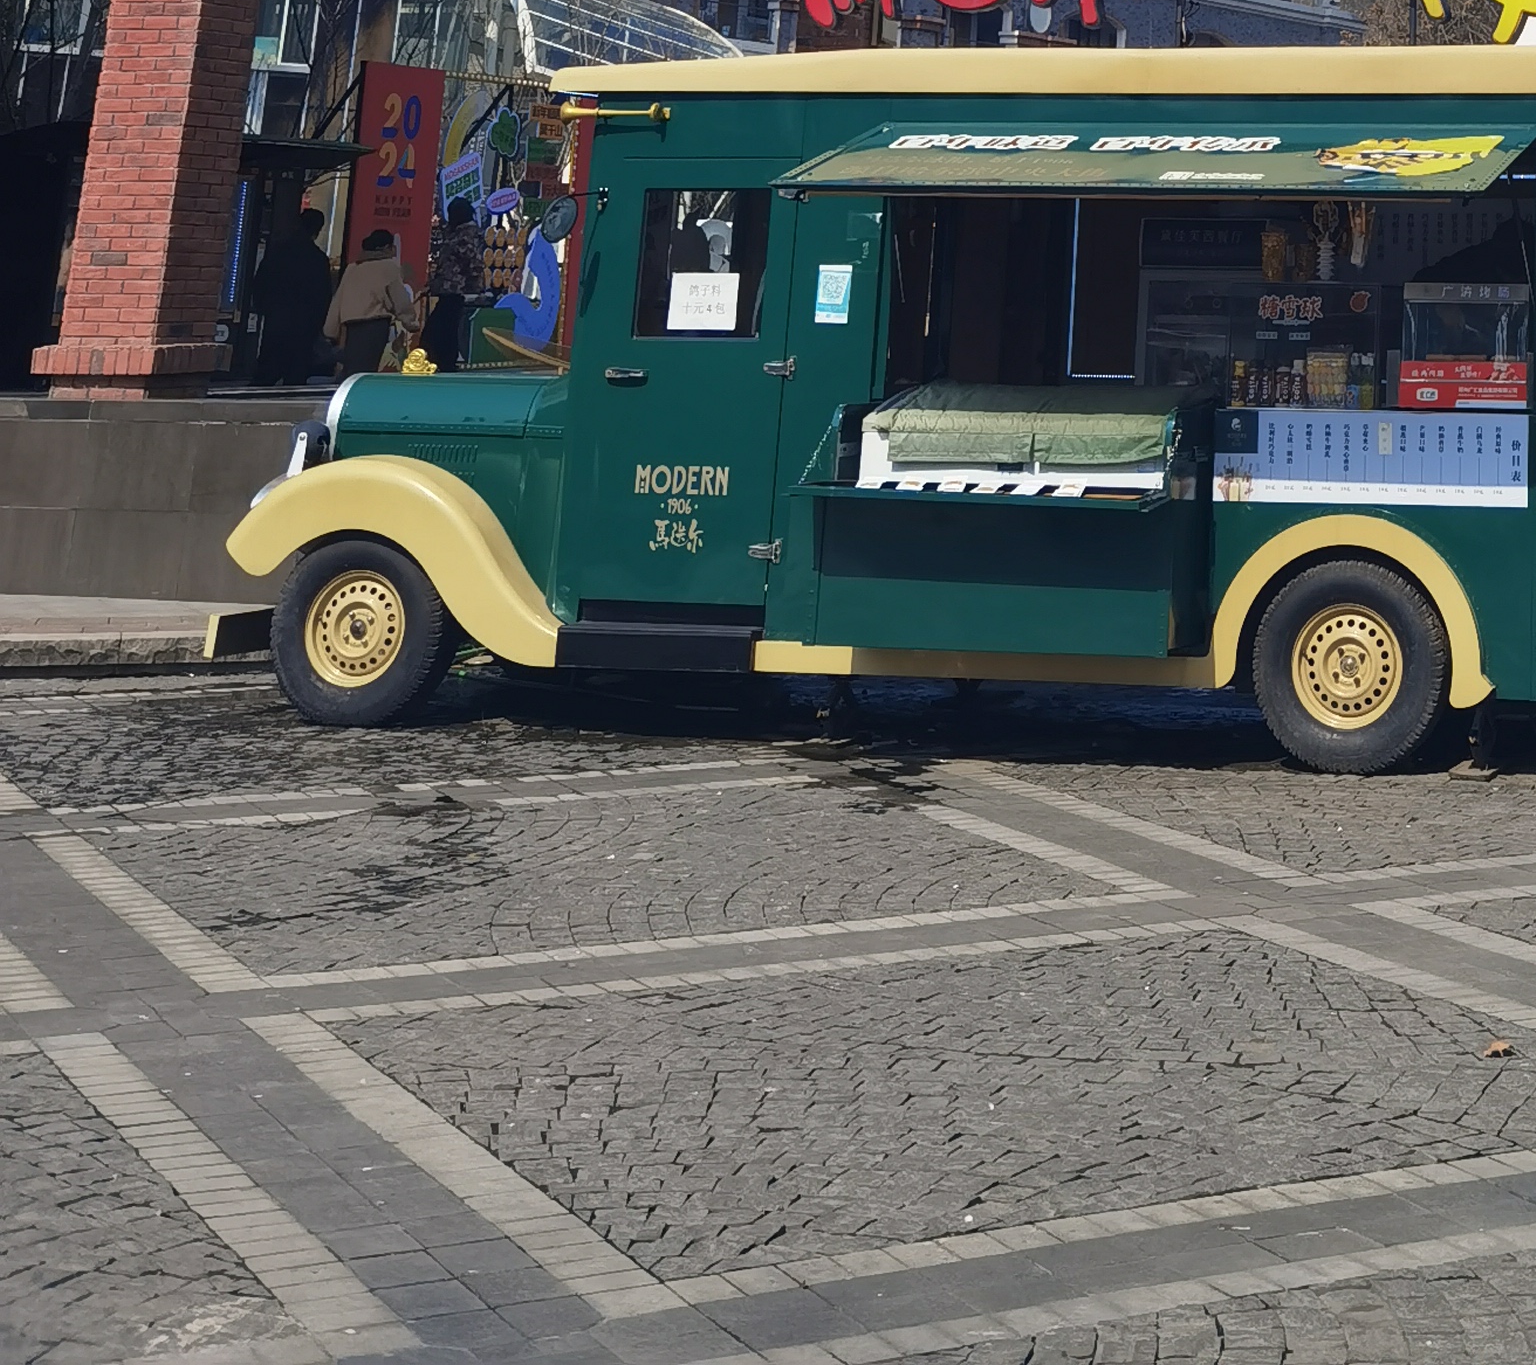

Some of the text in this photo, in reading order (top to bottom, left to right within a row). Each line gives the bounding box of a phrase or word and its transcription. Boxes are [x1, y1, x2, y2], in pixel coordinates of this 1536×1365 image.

[688, 284, 721, 297] 鸽子料
[1511, 440, 1521, 482] 价目表
[634, 464, 729, 496] MODERN
[667, 498, 692, 515] 1906
